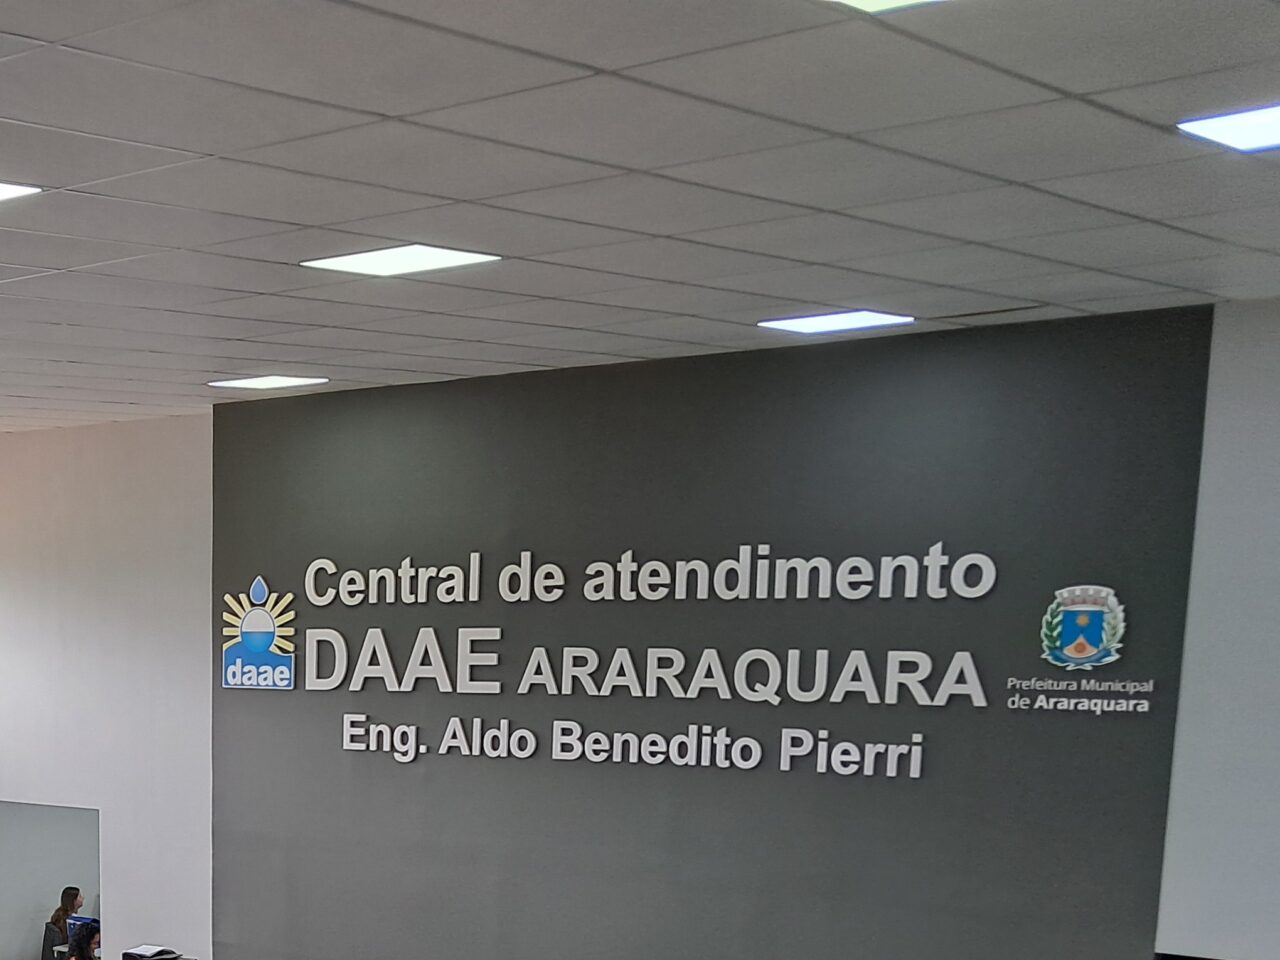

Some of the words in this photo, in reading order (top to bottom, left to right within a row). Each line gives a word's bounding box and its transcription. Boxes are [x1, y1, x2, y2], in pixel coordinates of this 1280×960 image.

[304, 552, 481, 606] Central
[498, 551, 565, 602] de
[583, 541, 997, 601] atendimento
[225, 658, 291, 687] daae
[304, 627, 502, 693] DAAE
[517, 647, 988, 707] ARARAQUARA
[1006, 677, 1077, 691] Prefeitura
[1080, 679, 1154, 695] Municipal
[1007, 693, 1031, 709] de
[1033, 694, 1150, 715] Araraquara
[342, 713, 428, 763] Eng.
[438, 716, 537, 759] Aldo
[552, 720, 763, 770] Benedito
[780, 728, 923, 778] Pierri
